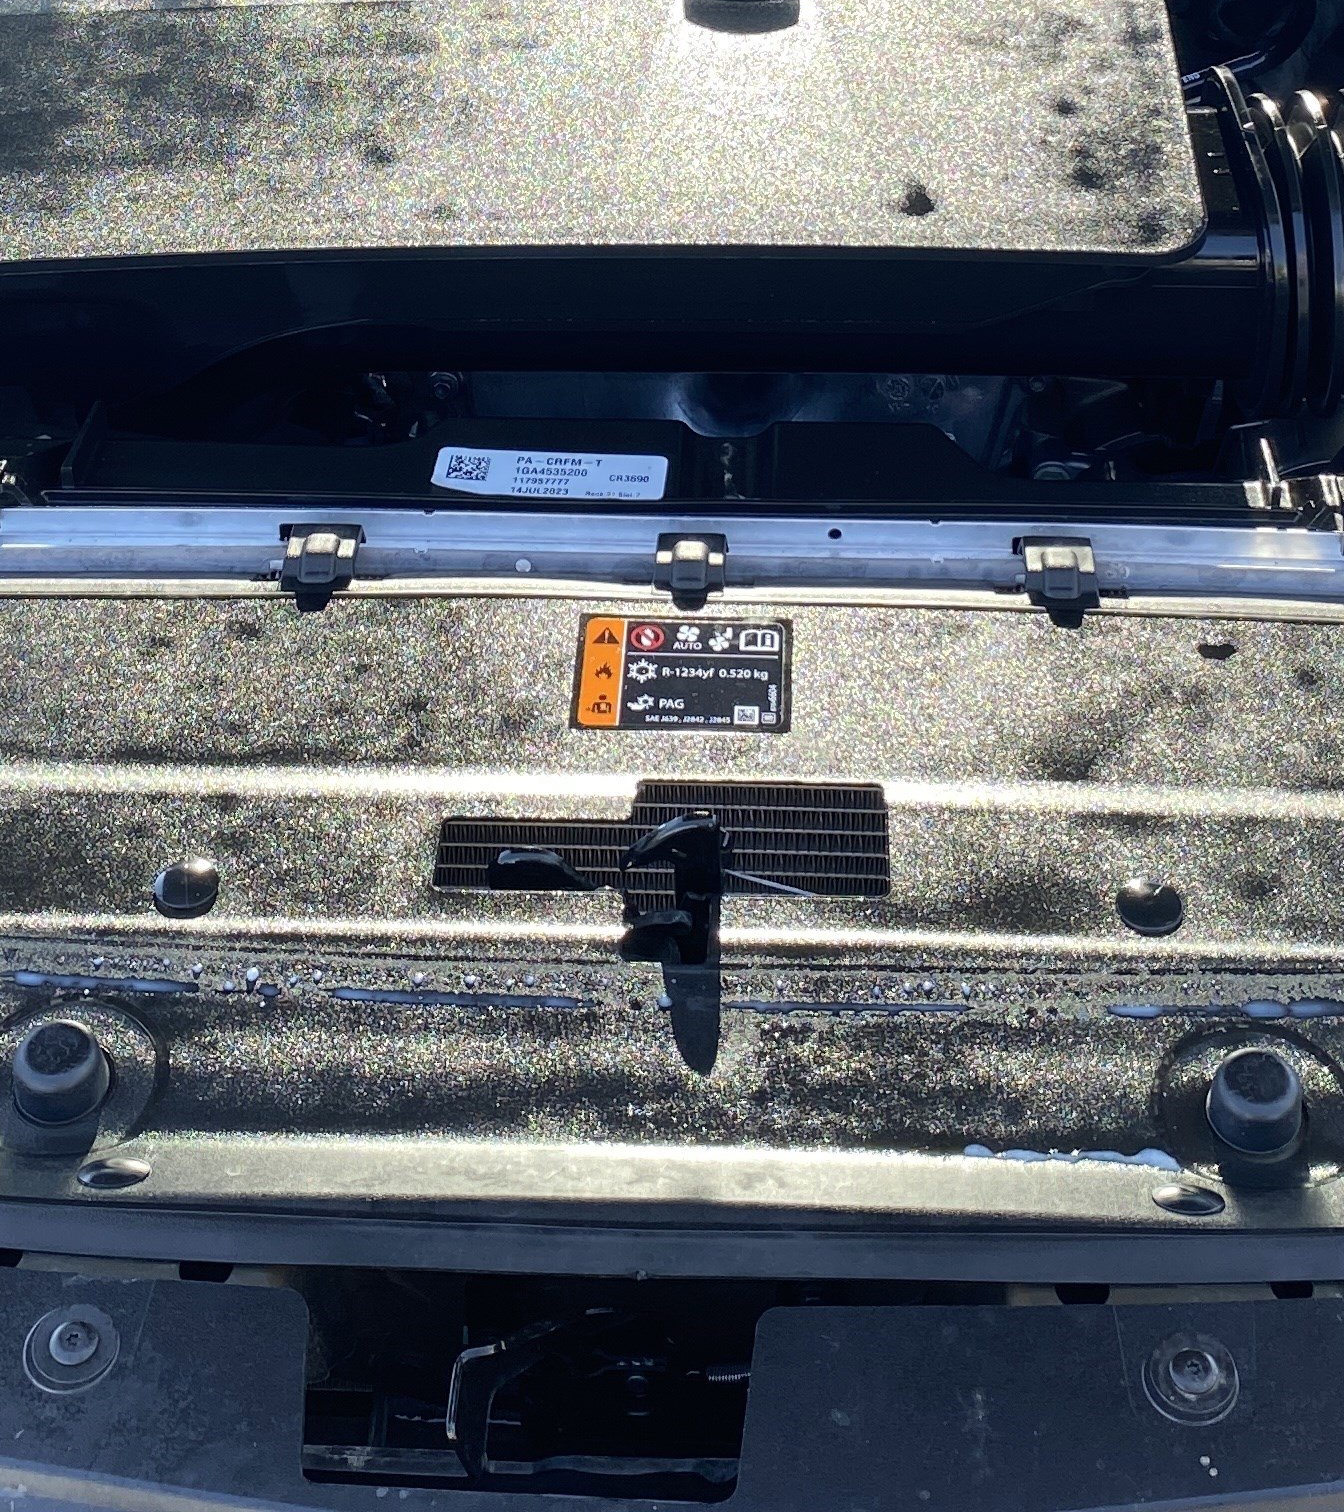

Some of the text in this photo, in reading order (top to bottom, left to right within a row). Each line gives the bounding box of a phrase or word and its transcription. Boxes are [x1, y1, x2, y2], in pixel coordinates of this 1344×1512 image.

[510, 486, 570, 496] 14JUL2023
[672, 641, 703, 651] AUTO
[662, 666, 769, 682] R-1234yf 0.520 kg
[659, 698, 685, 710] PAG
